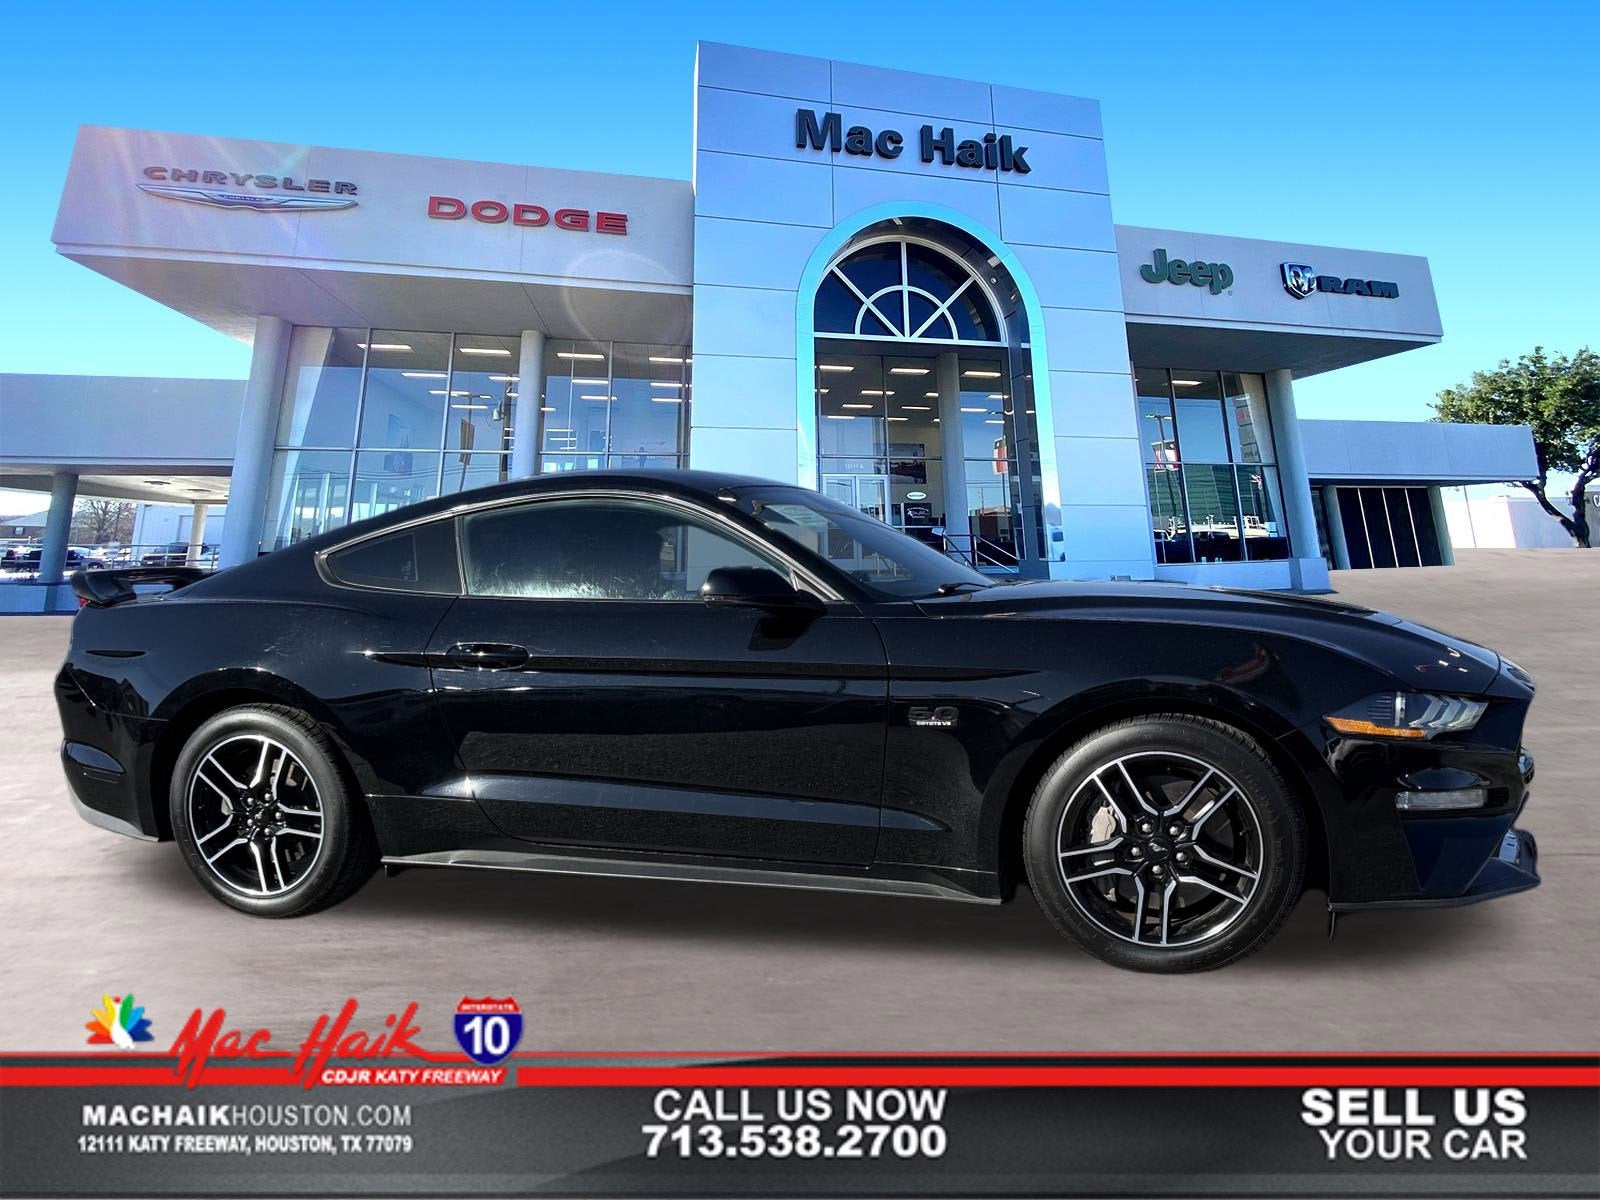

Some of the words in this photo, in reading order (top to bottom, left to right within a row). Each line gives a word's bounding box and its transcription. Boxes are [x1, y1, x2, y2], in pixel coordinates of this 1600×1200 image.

[796, 108, 904, 159] Mac
[920, 124, 1032, 174] Haik
[143, 166, 358, 196] CHRYSLER
[428, 196, 628, 236] DODGE
[1140, 248, 1234, 295] Jeep
[1316, 275, 1399, 299] RAM
[908, 706, 959, 721] 5.0
